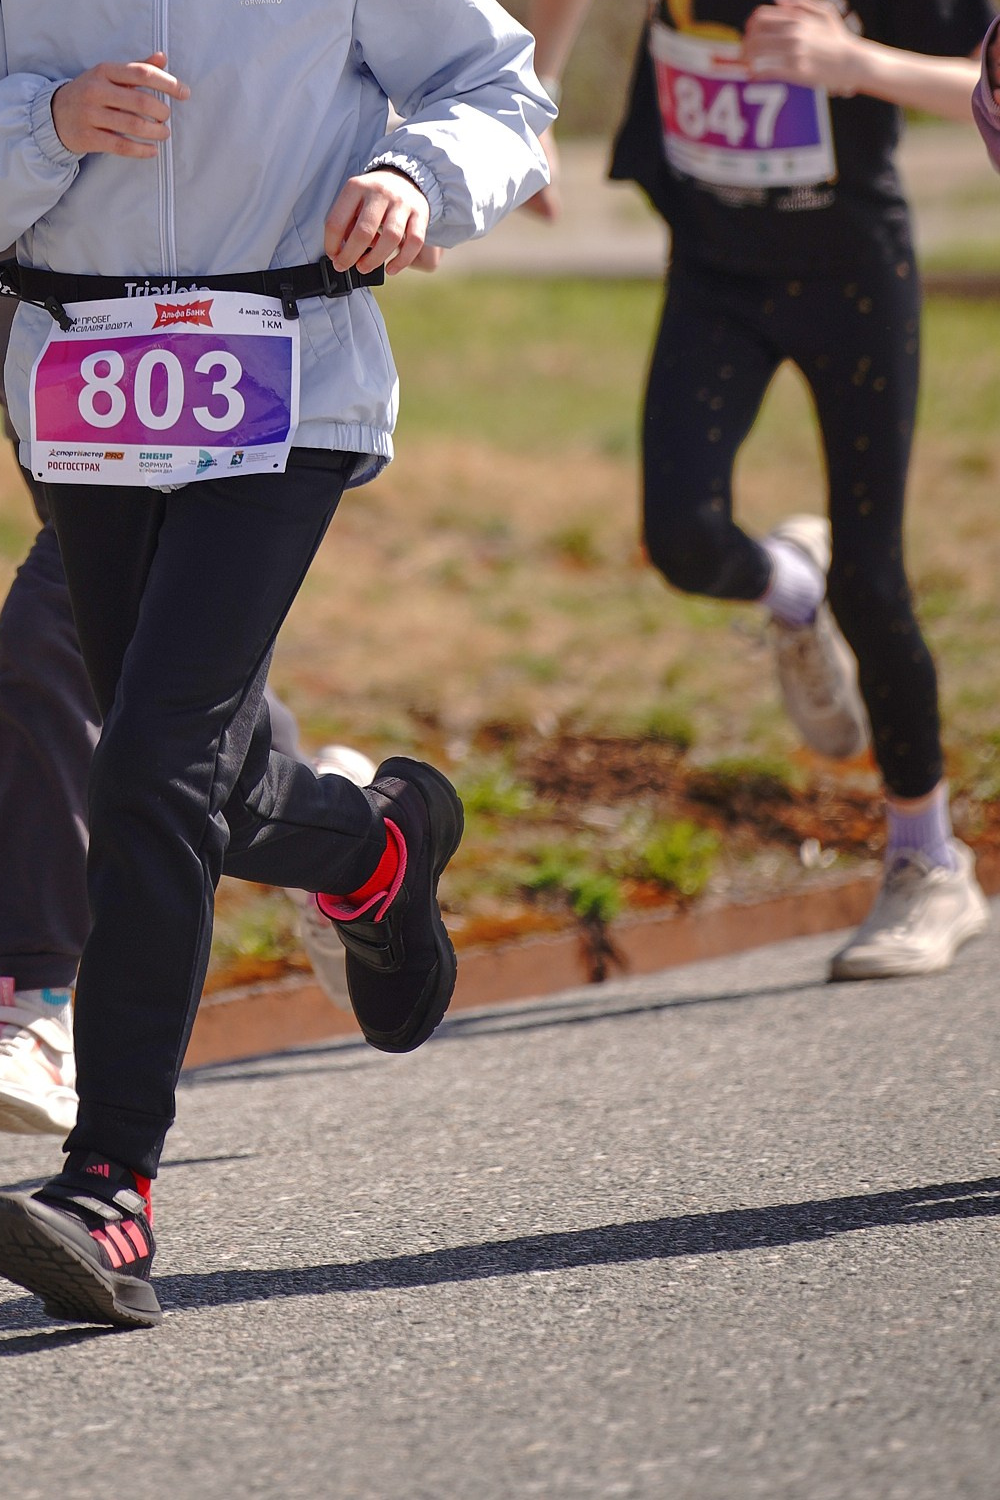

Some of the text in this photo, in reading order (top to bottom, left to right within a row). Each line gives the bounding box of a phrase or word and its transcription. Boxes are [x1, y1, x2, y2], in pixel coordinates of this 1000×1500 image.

[675, 75, 788, 149] 847
[160, 307, 206, 323] Альфа Банк
[238, 307, 244, 315] 4
[261, 308, 282, 318] 2025
[81, 315, 112, 325] ПРОБЕГ
[77, 348, 246, 433] 803
[105, 452, 124, 460] PRO
[139, 452, 173, 461] СИБУР
[47, 461, 100, 472] РОСГОССТРАХ
[139, 461, 173, 469] ФОРМУЛА
